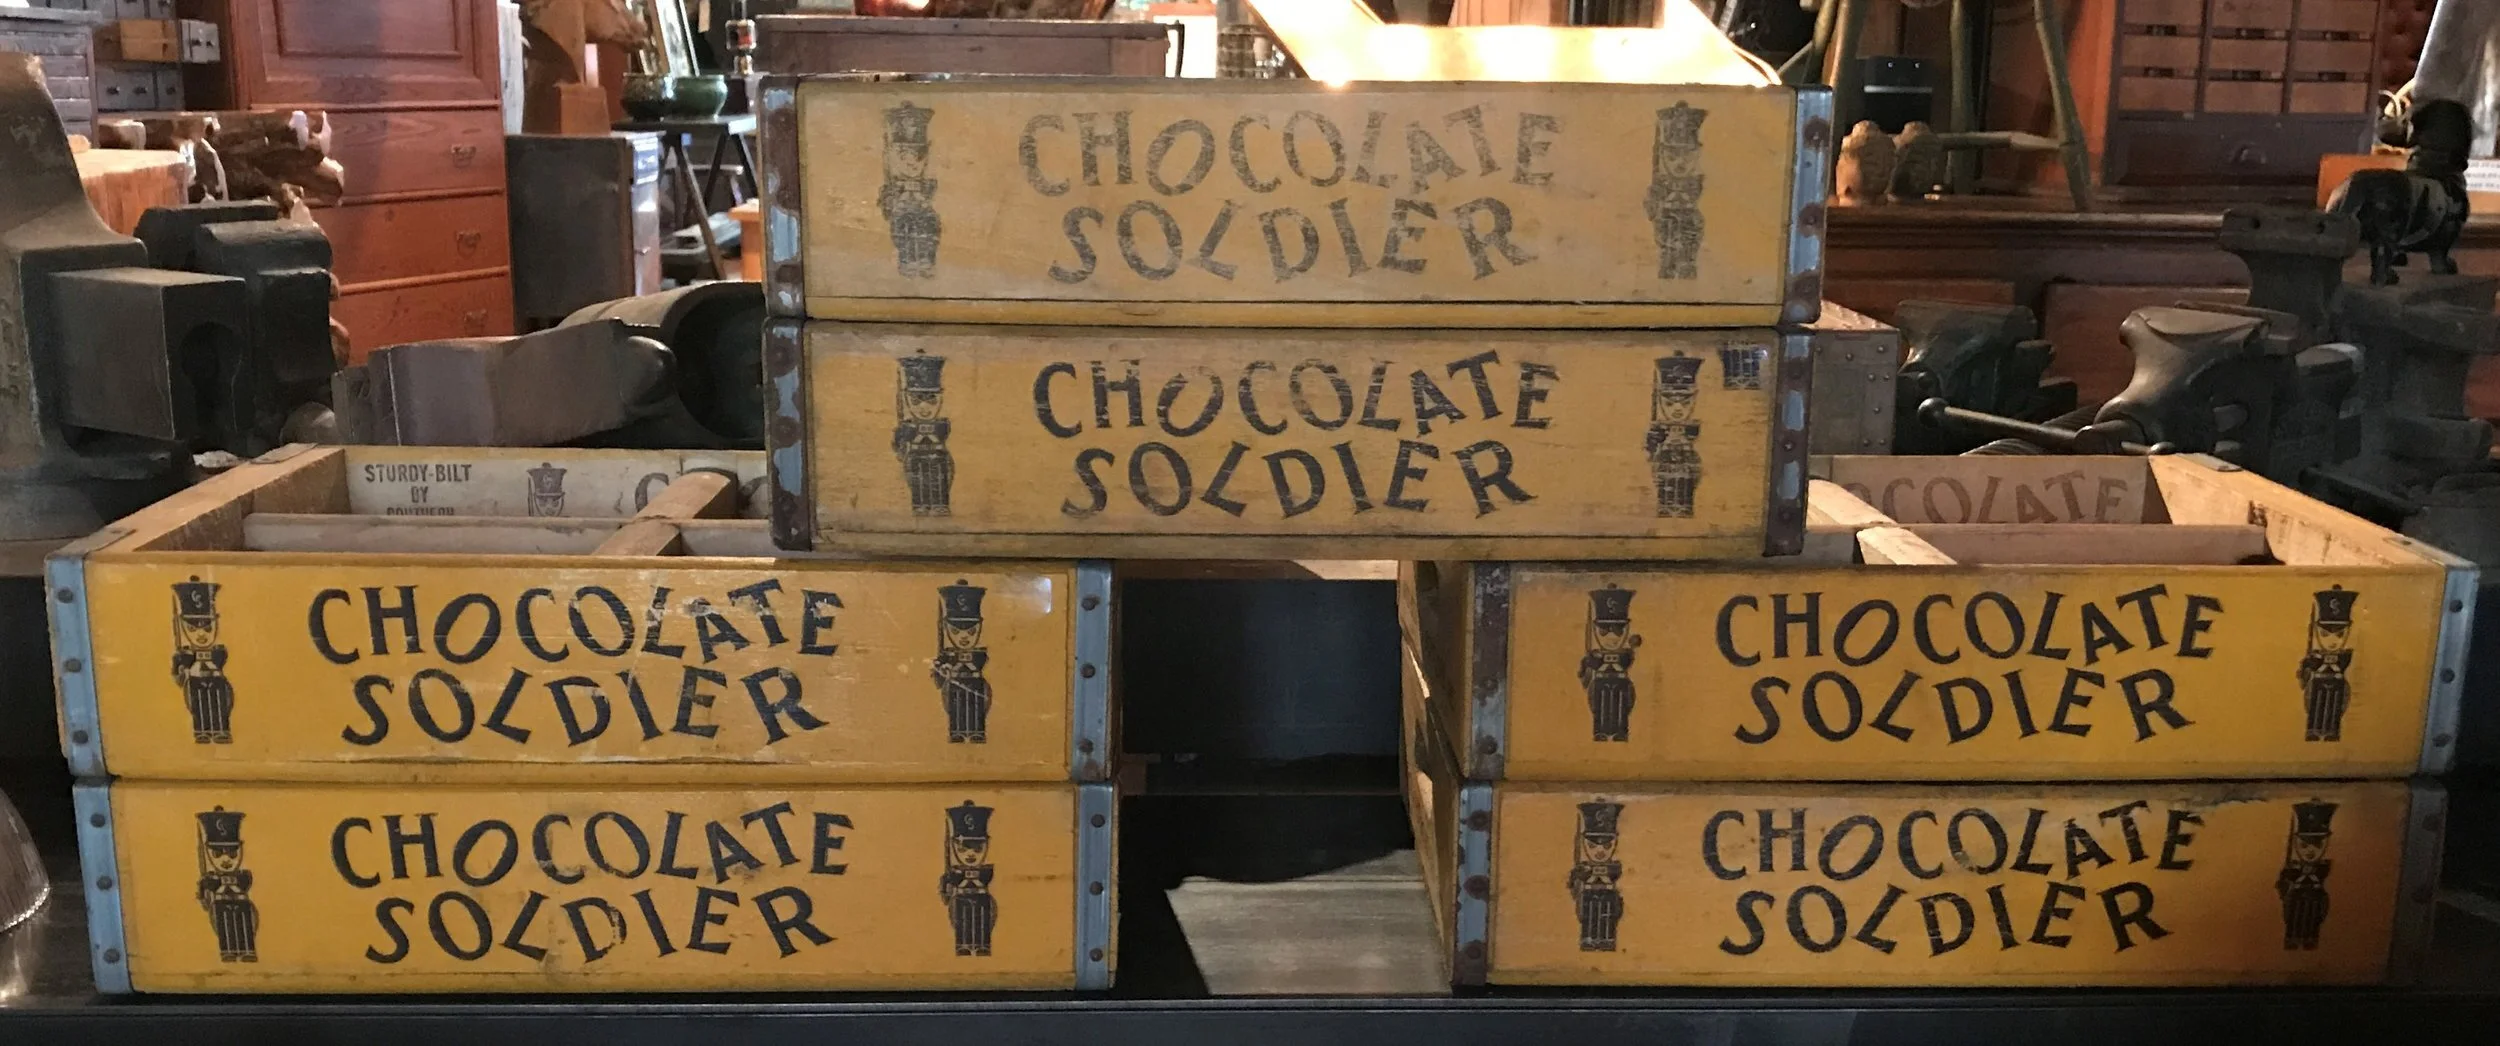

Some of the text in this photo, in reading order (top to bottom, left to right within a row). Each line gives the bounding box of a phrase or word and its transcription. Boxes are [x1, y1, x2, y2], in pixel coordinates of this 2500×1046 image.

[1018, 104, 1561, 197] CHOCOLATE
[1048, 197, 1537, 284] SOLDIER
[1033, 349, 1561, 438] CHOCOLATE
[364, 464, 472, 482] STURDY-BILT
[1060, 439, 1537, 519] SOLDIER
[308, 578, 845, 665] CHOCOLATE
[1715, 584, 2224, 667] CHOCOLATE
[342, 665, 830, 747] SOLDIER
[1734, 667, 2195, 745] SOLDIER
[331, 801, 854, 889] CHOCOLATE
[1702, 801, 2205, 881] CHOCOLATE
[365, 885, 838, 963] SOLDIER
[1719, 881, 2173, 957] SOLDIER
